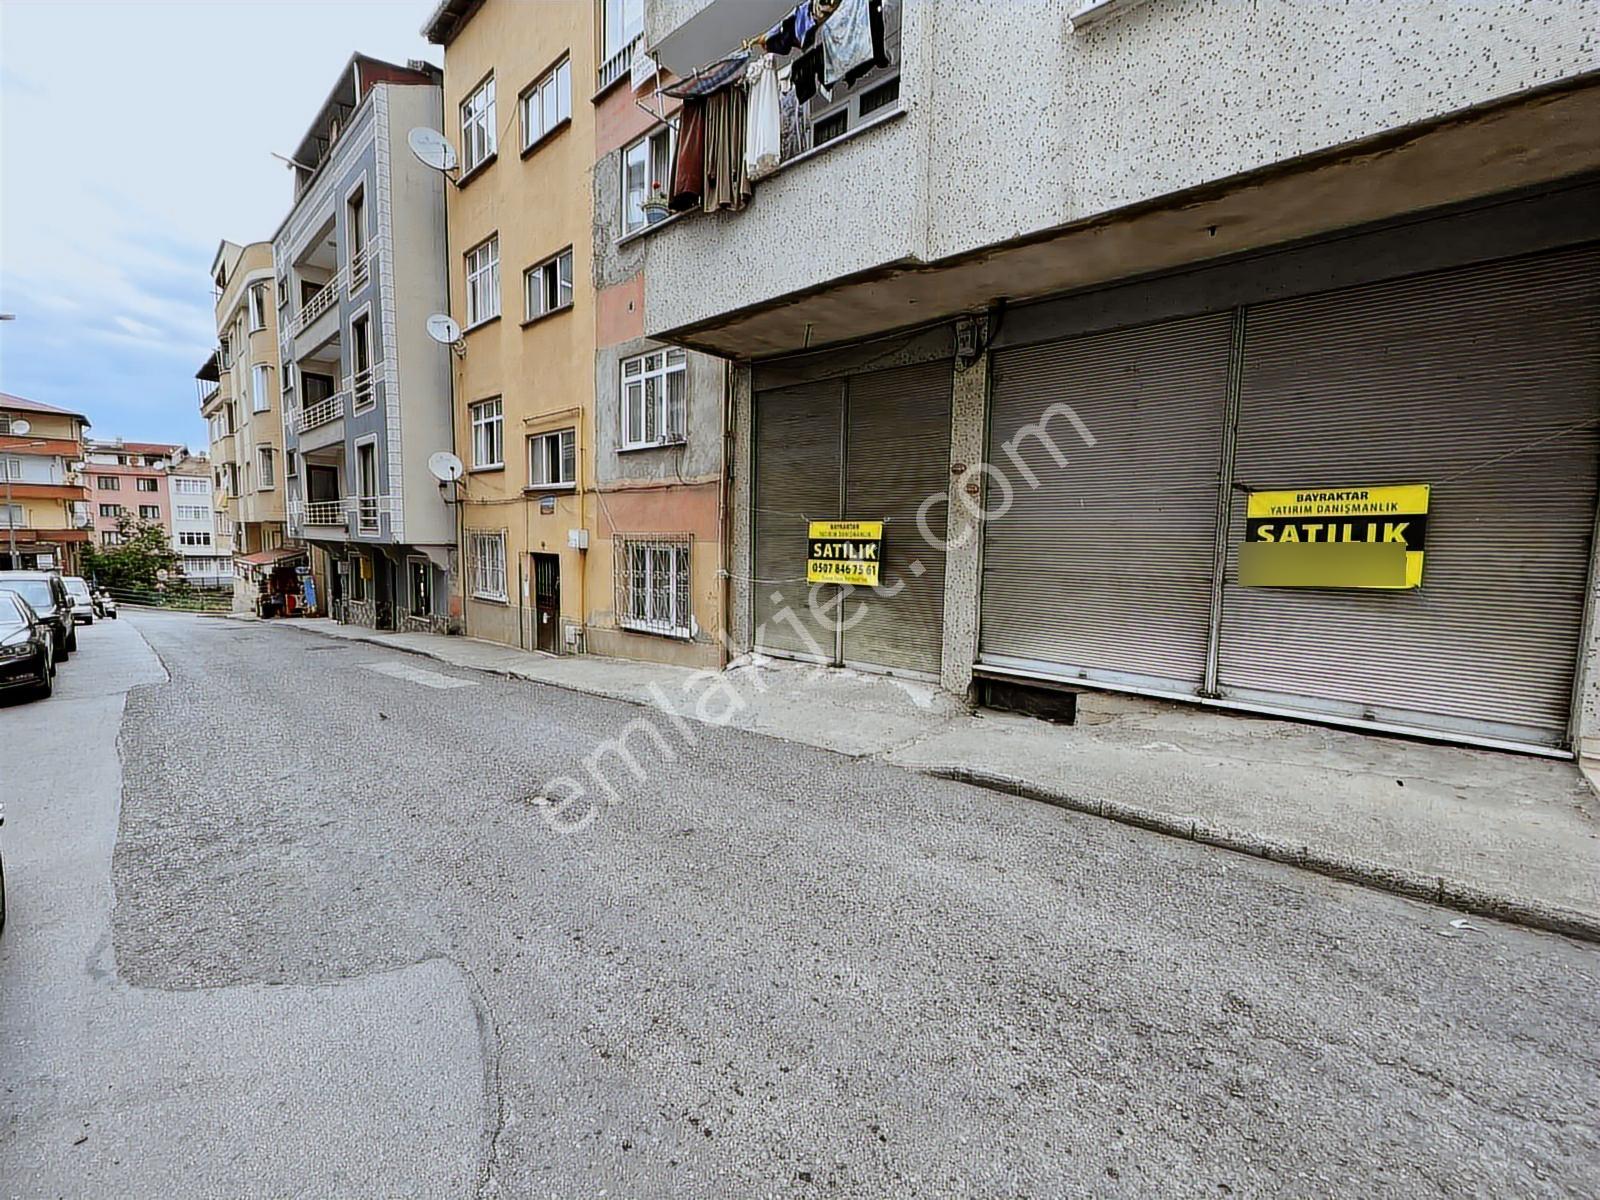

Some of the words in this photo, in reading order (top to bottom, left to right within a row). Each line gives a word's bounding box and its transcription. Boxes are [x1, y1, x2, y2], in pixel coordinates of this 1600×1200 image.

[1296, 491, 1369, 503] BAYRAKTAR
[1270, 505, 1313, 516] YATIRIM
[1316, 502, 1399, 515] DANIŞMANLIK
[1256, 522, 1411, 547] SATILIK
[813, 543, 877, 560] SATILIK
[812, 562, 833, 574] 0507
